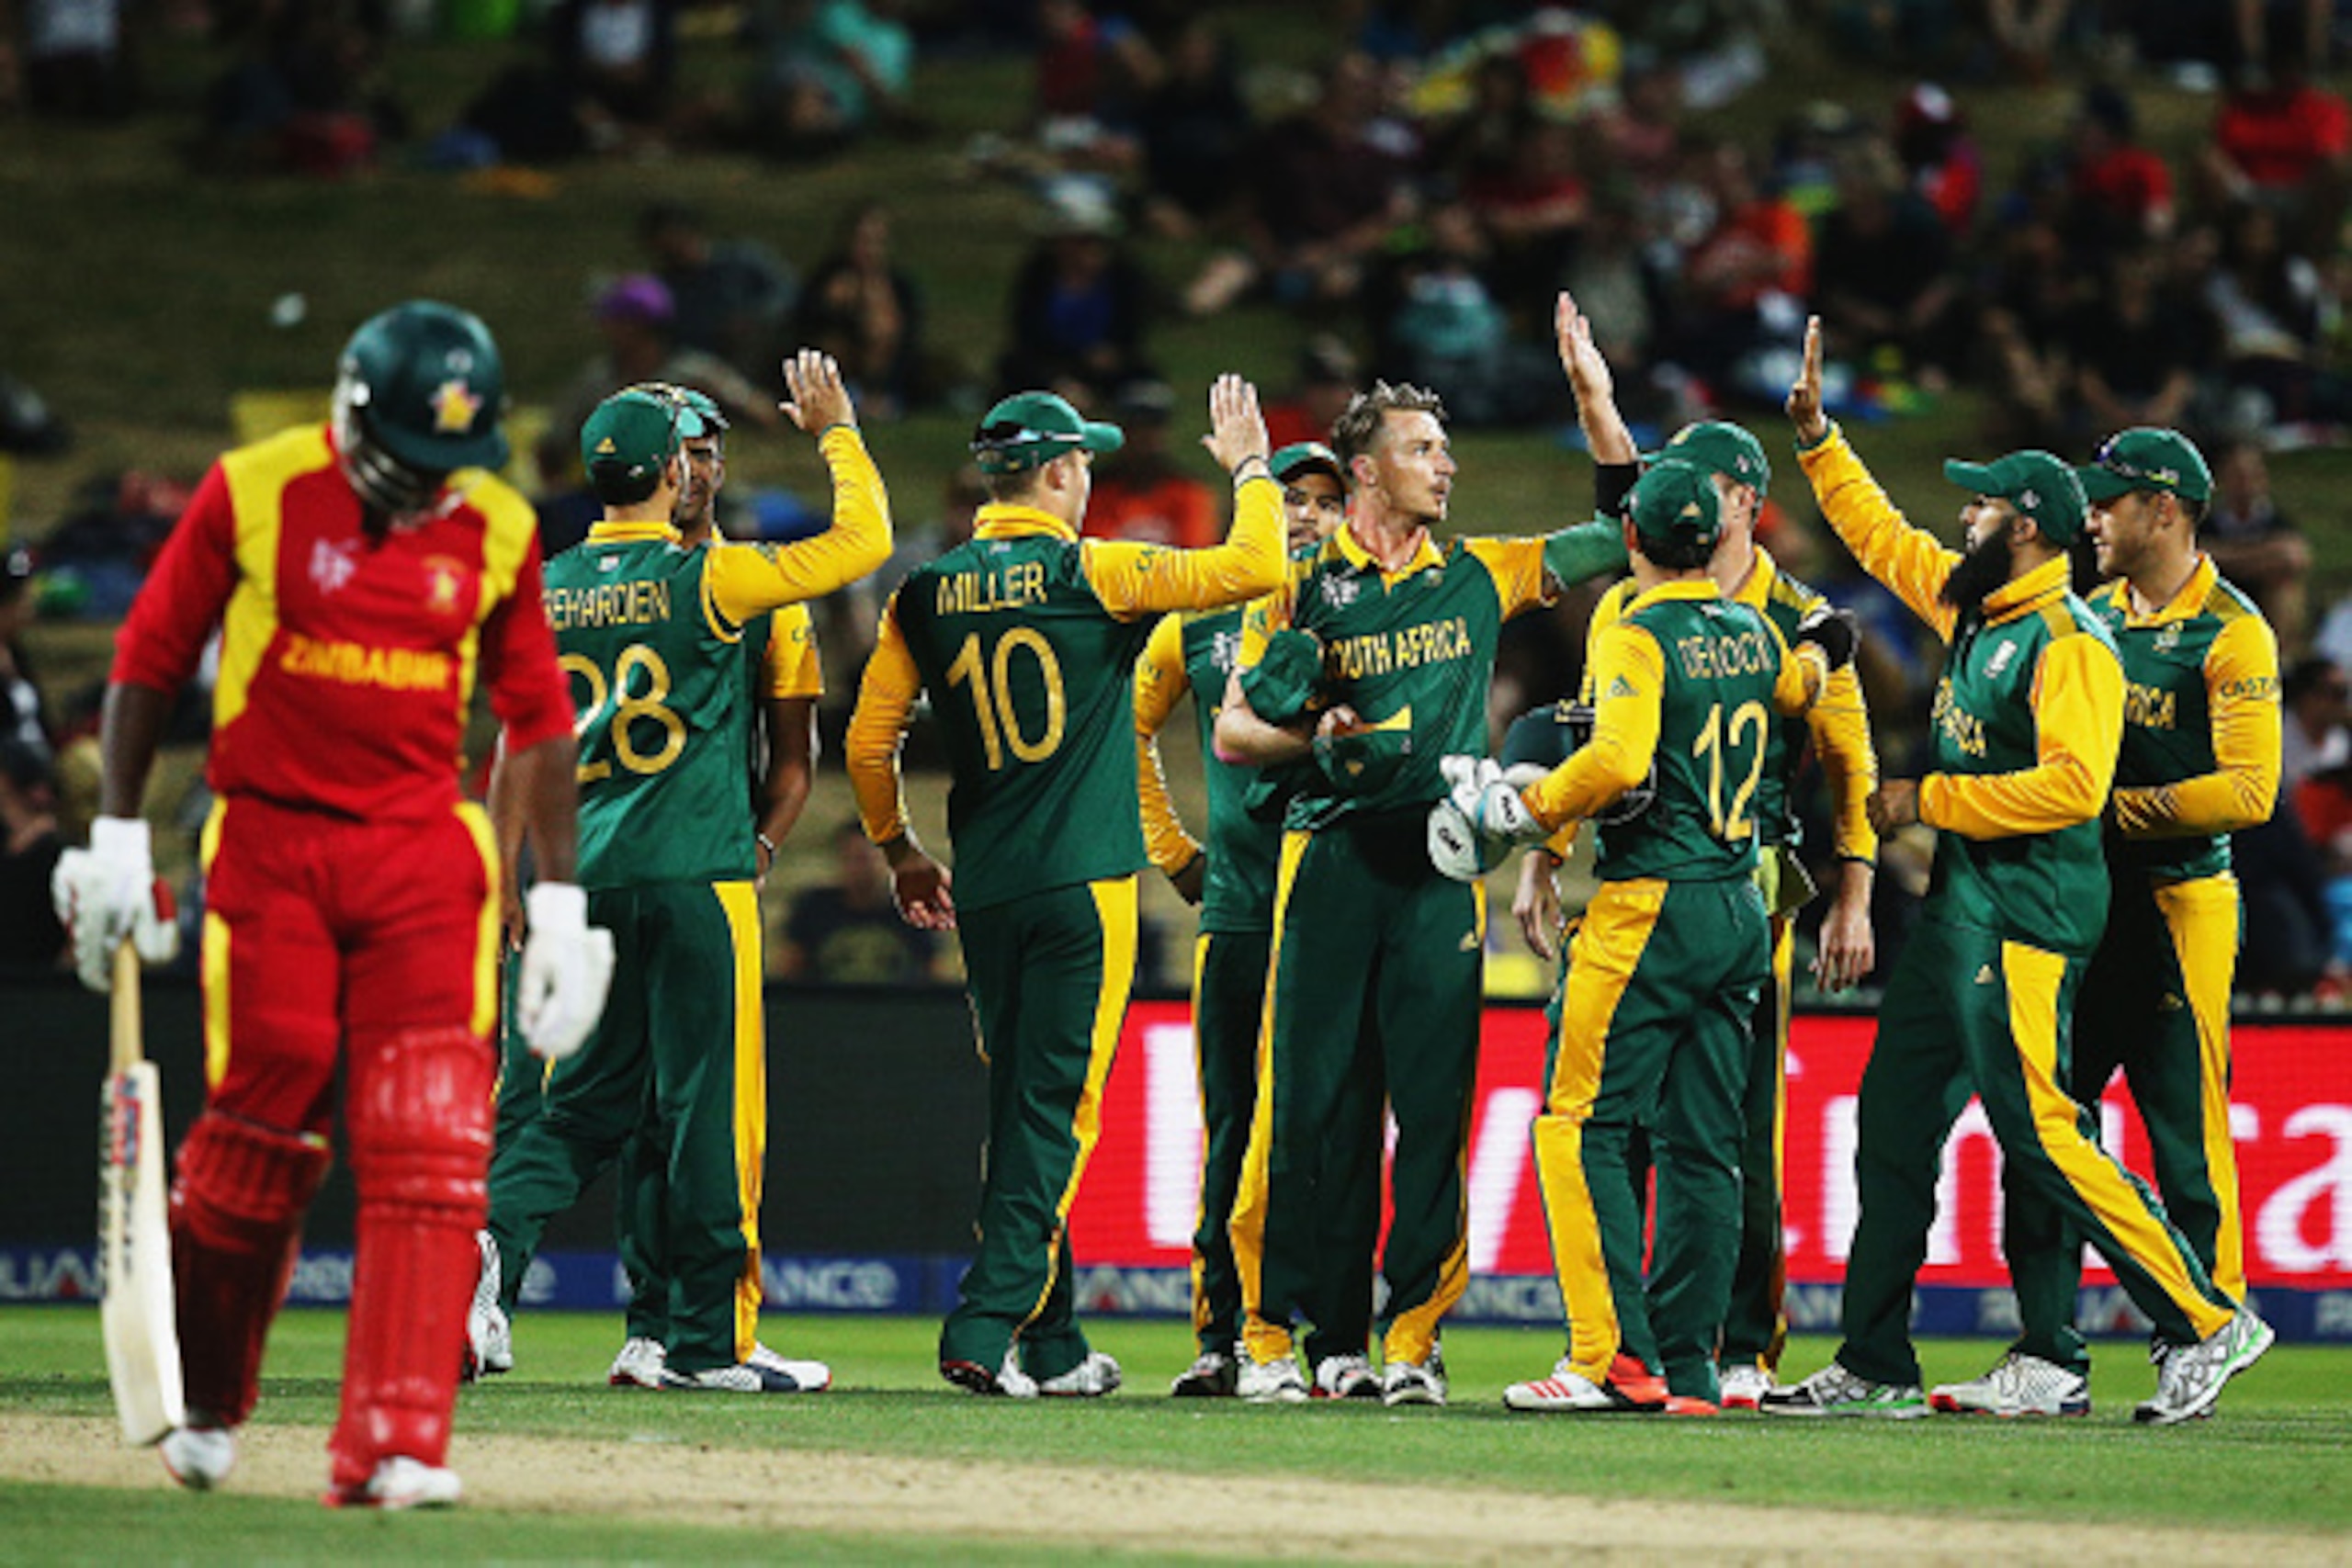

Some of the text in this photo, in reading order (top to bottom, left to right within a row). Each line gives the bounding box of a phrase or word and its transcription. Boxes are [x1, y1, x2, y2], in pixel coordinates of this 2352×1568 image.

[935, 560, 1049, 616] MILLER
[1394, 616, 1472, 671] AFRICA
[558, 644, 687, 782] 28
[944, 626, 1068, 772] 10
[1692, 700, 1769, 841] 12
